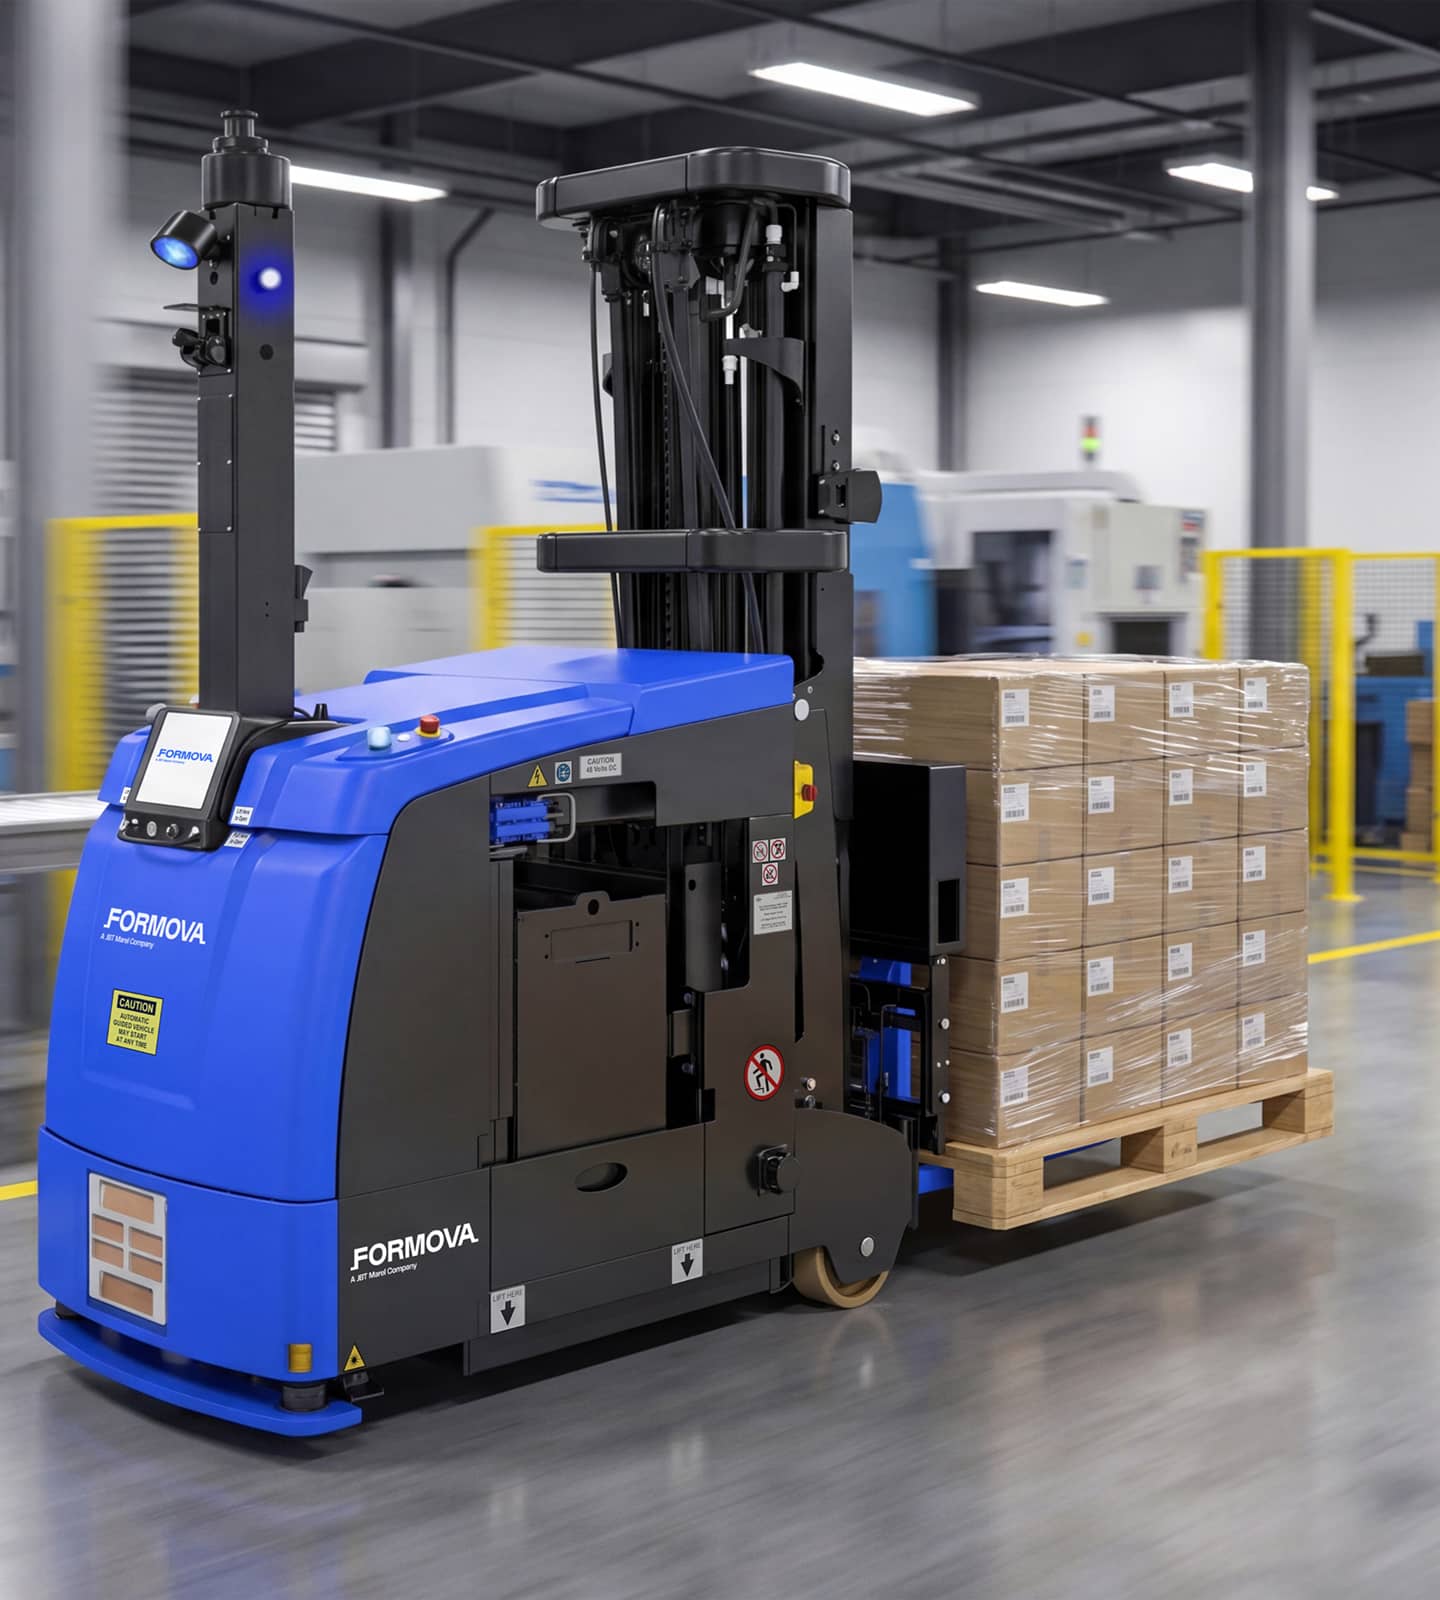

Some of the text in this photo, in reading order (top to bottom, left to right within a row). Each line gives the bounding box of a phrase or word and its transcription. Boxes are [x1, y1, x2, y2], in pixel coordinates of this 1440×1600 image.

[157, 748, 213, 762] FORMOVA
[587, 756, 615, 765] CAUTION
[104, 907, 206, 945] FORMOVA
[130, 937, 154, 950] Company
[119, 997, 155, 1014] CAUTION
[120, 1012, 150, 1025] AUTOMATIC
[113, 1018, 155, 1035] GUIDED VEHICLE
[118, 1027, 148, 1041] MAY START
[116, 1035, 148, 1049] AT ANY TIME
[350, 1223, 479, 1271] FORMOVA
[673, 1242, 701, 1256] LIFT HERE
[387, 1262, 418, 1275] Company
[492, 1288, 522, 1302] LIFT HERE
